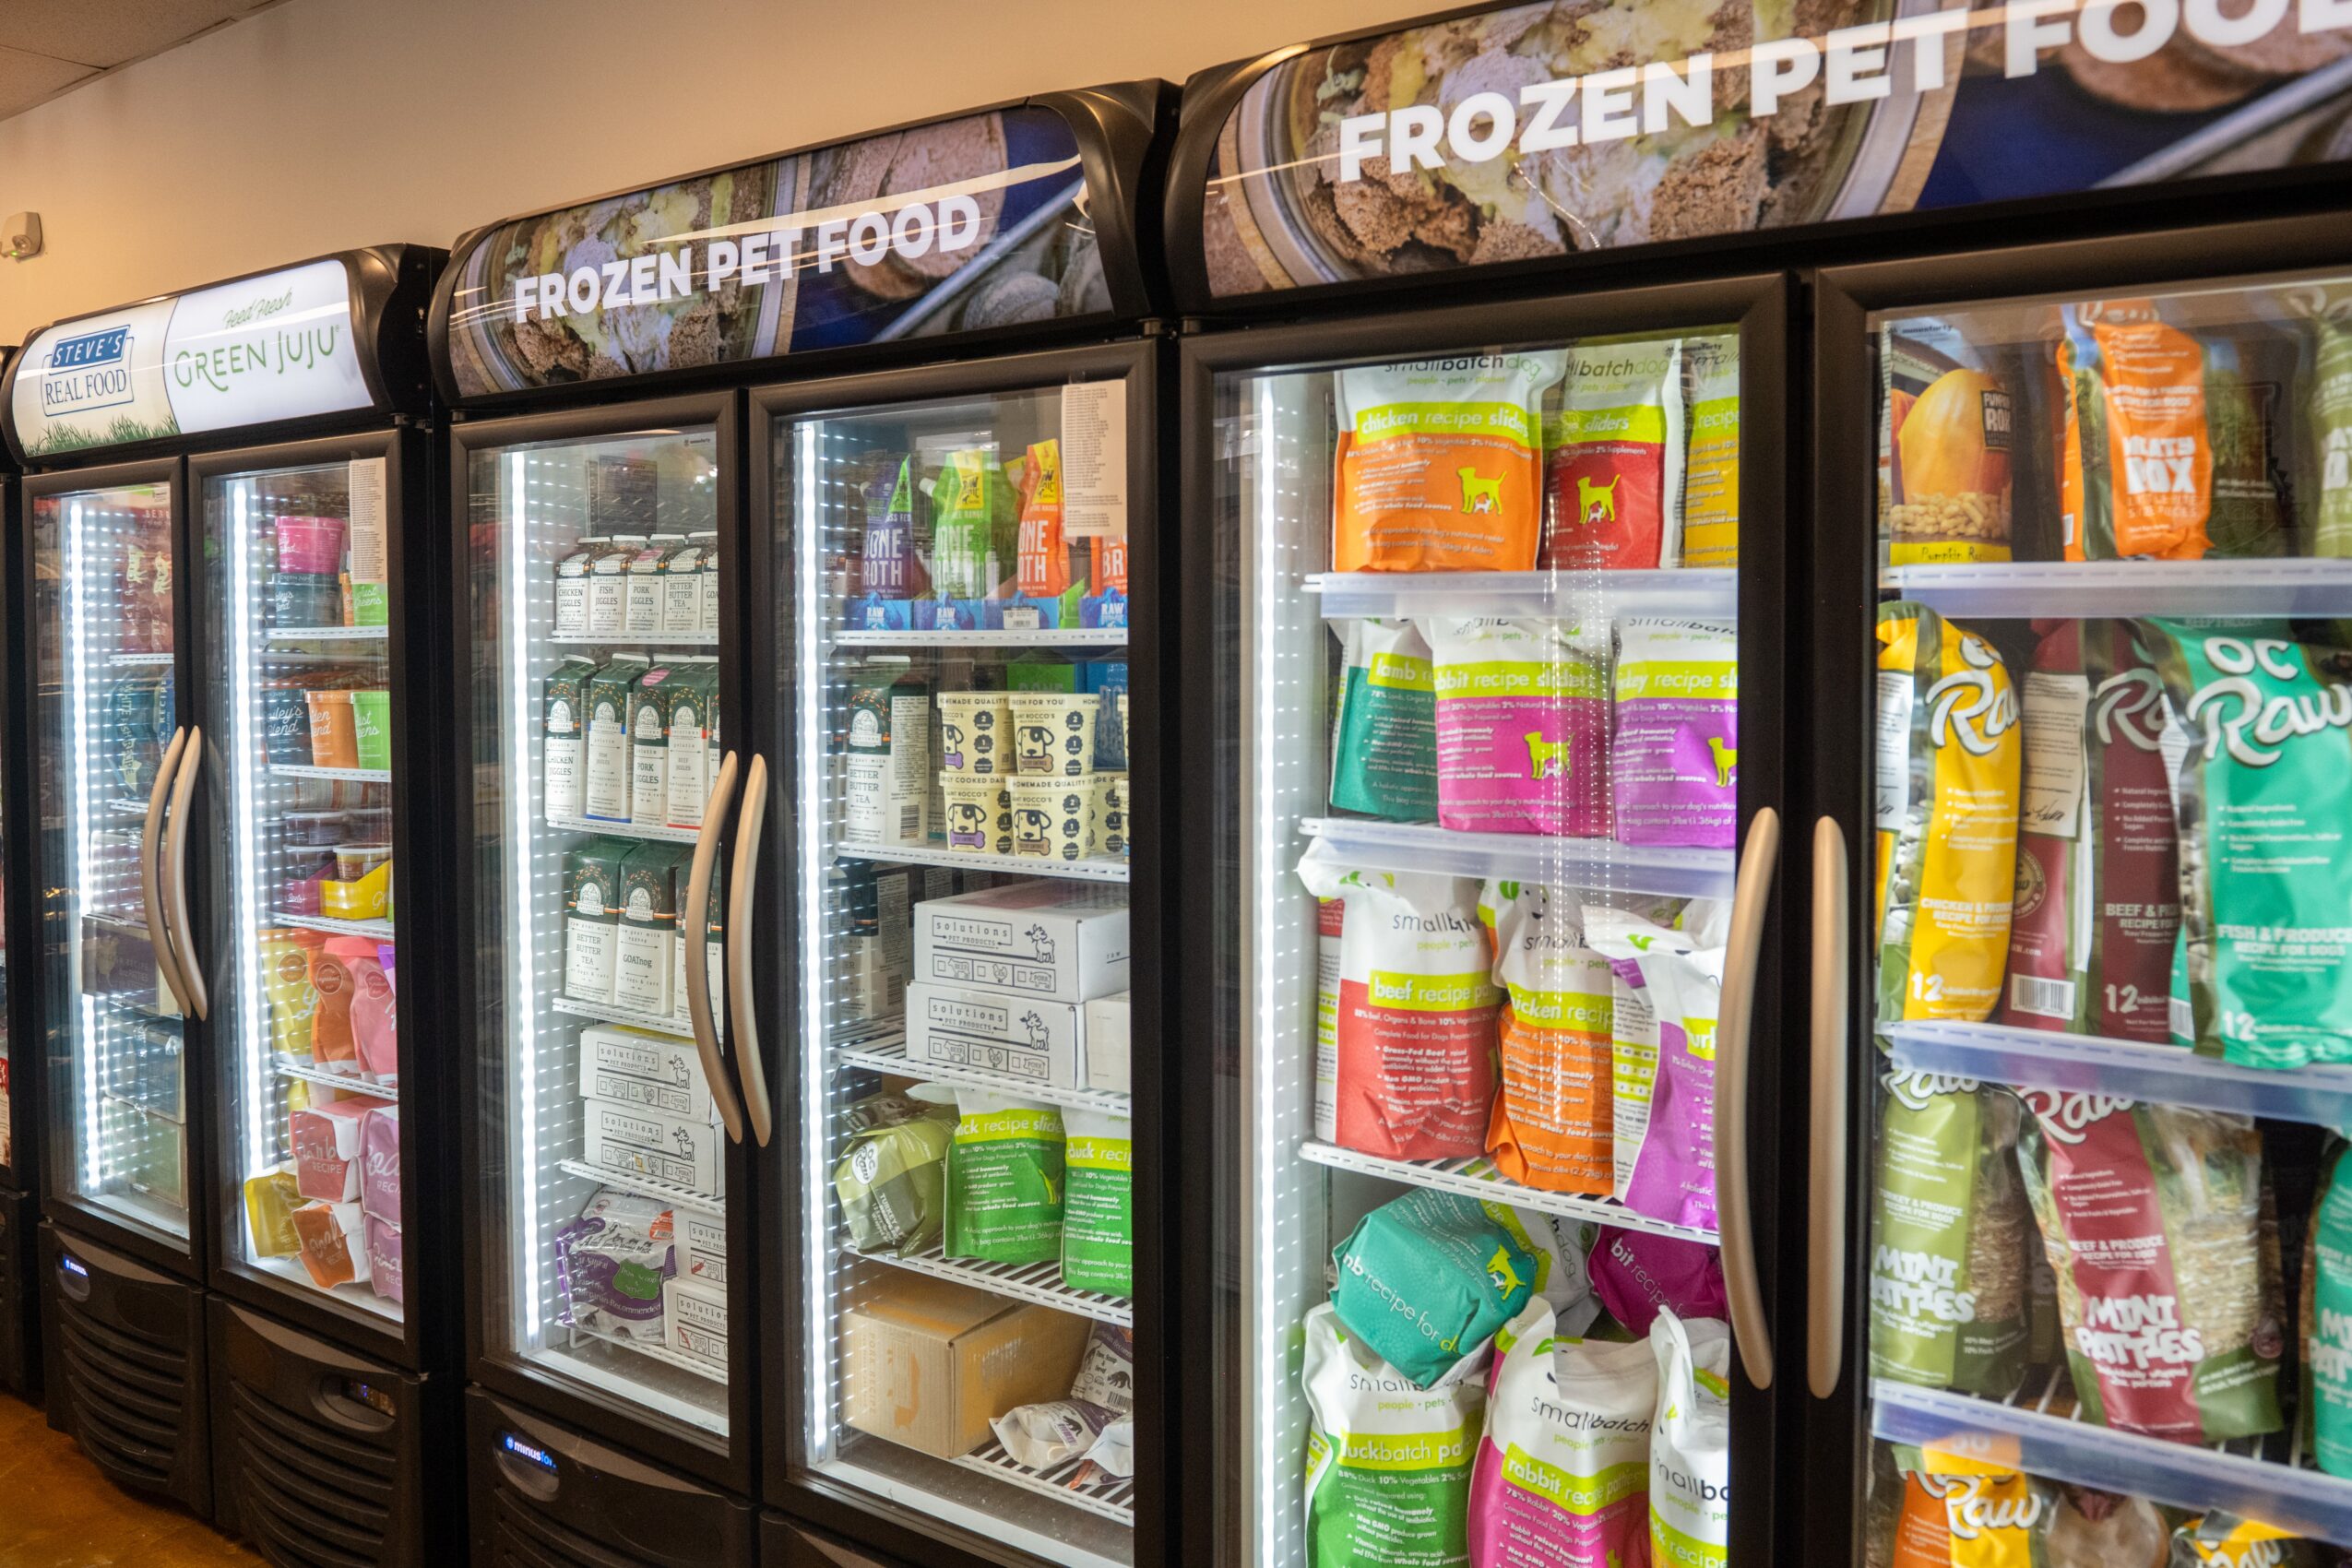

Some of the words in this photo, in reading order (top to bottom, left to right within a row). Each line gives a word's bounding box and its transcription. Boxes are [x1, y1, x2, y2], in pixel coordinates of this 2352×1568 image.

[1339, 52, 1713, 184] FROZEN
[1751, 7, 1967, 118] PET
[2003, 0, 2352, 79] FOO
[514, 248, 693, 324] FROZEN
[707, 228, 802, 294] PET
[818, 194, 981, 274] FOOD
[222, 302, 255, 329] Feed
[254, 287, 292, 320] Fresh
[53, 335, 123, 365] STEVE'S
[174, 340, 267, 391] GREEN
[278, 325, 336, 374] JUJU
[45, 376, 83, 406] REAL
[87, 369, 127, 399] FOOD
[1447, 375, 1467, 385] pets
[1361, 410, 1418, 434] chicken
[1425, 411, 1482, 429] recipe
[1489, 408, 1529, 439] sliders
[1584, 413, 1629, 433] sliders
[2123, 434, 2196, 457] MEATY
[2126, 456, 2196, 494] ROX
[864, 529, 903, 558] ONE
[1018, 520, 1049, 552] ONE
[633, 586, 650, 594] PORK
[669, 590, 693, 600] BUTTER
[595, 598, 618, 606] JIGGLES
[630, 598, 654, 606] JIGGLES
[673, 600, 686, 608] TEA
[2204, 636, 2299, 680] OC
[1376, 658, 1417, 681] lamb
[1475, 670, 1529, 691] recipe
[1655, 670, 1713, 694] recipe
[1926, 671, 2020, 755] Ra
[2096, 667, 2165, 751] Ra
[2186, 683, 2352, 769] Raw
[636, 762, 655, 772] PORK
[849, 769, 879, 780] BETTER
[636, 775, 659, 784] JIGGLES
[849, 782, 879, 792] BUTTER
[1054, 779, 1085, 788] QUALITY
[854, 794, 871, 804] TEA
[1920, 897, 1973, 913] CHICKEN
[2105, 903, 2142, 917] BEEF
[2144, 903, 2156, 917] &
[1932, 909, 1972, 924] RECIPE
[2119, 918, 2157, 931] RECIPE
[935, 921, 1008, 937] solutions
[2218, 924, 2257, 940] FISH
[2260, 926, 2272, 940] &
[576, 933, 601, 945] BETTER
[961, 937, 996, 946] PRODUCTS
[576, 944, 601, 956] BUTTER
[2233, 942, 2277, 956] RECIPE
[2280, 944, 2307, 956] FOR
[2309, 944, 2346, 956] DOGS
[580, 956, 594, 966] TEA
[623, 954, 653, 968] GOATnog
[1587, 959, 1610, 970] pets
[1374, 976, 1413, 1001] beef
[1418, 984, 1470, 1006] recipe
[1911, 973, 1943, 1003] 12
[2105, 983, 2140, 1014] 12
[932, 1003, 1004, 1023] solutions
[1438, 1016, 1455, 1026] 10%
[958, 1019, 992, 1031] PRODUCTS
[2222, 1009, 2258, 1042] 12
[1402, 1030, 1420, 1039] Food
[1431, 1033, 1449, 1042] Dogs
[600, 1047, 657, 1064] solutions
[1383, 1045, 1423, 1056] Grass-Fed
[1425, 1046, 1446, 1057] Beef
[1028, 1061, 1042, 1070] PORK
[1401, 1075, 1422, 1083] GMO
[604, 1116, 660, 1135] solutions
[984, 1119, 1028, 1134] recipe
[1539, 1122, 1564, 1134] Whole
[1566, 1128, 1587, 1137] food
[866, 1146, 876, 1170] OC
[1068, 1142, 1094, 1159] duck
[312, 1161, 342, 1175] RECIPE
[855, 1146, 870, 1182] Raw
[1099, 1173, 1128, 1182] Vegetables
[880, 1193, 897, 1229] TURKEY
[980, 1237, 992, 1246] bag
[1874, 1244, 1959, 1289] MINI
[1631, 1262, 1670, 1313] recipe
[1365, 1271, 1417, 1321] recipe
[1416, 1311, 1440, 1341] for
[2087, 1293, 2179, 1332] MINI
[2075, 1324, 2205, 1369] PATTIES
[1377, 1401, 1414, 1411] people
[1424, 1398, 1445, 1411] pets
[1358, 1474, 1376, 1484] Duck
[1378, 1475, 1398, 1484] 10%
[1399, 1476, 1440, 1486] Vegetables
[1441, 1472, 1456, 1482] 2%
[1507, 1458, 1562, 1495] rabbit
[1503, 1502, 1532, 1522] Complete
[1505, 1486, 1526, 1503] 78%
[1526, 1495, 1550, 1514] Rabbit
[1551, 1508, 1571, 1526] 20%
[1665, 1491, 1700, 1515] people
[1947, 1476, 2041, 1539] Raw
[1356, 1514, 1372, 1526] Non
[1372, 1518, 1391, 1533] GMO
[1416, 1529, 1437, 1539] grown
[1510, 1523, 1532, 1538] Rabbit
[1534, 1533, 1559, 1551] raised
[1378, 1555, 1393, 1565] from
[1394, 1558, 1420, 1567] Whole
[1421, 1557, 1441, 1567] food
[1507, 1546, 1524, 1559] Non
[1525, 1553, 1545, 1568] GMO
